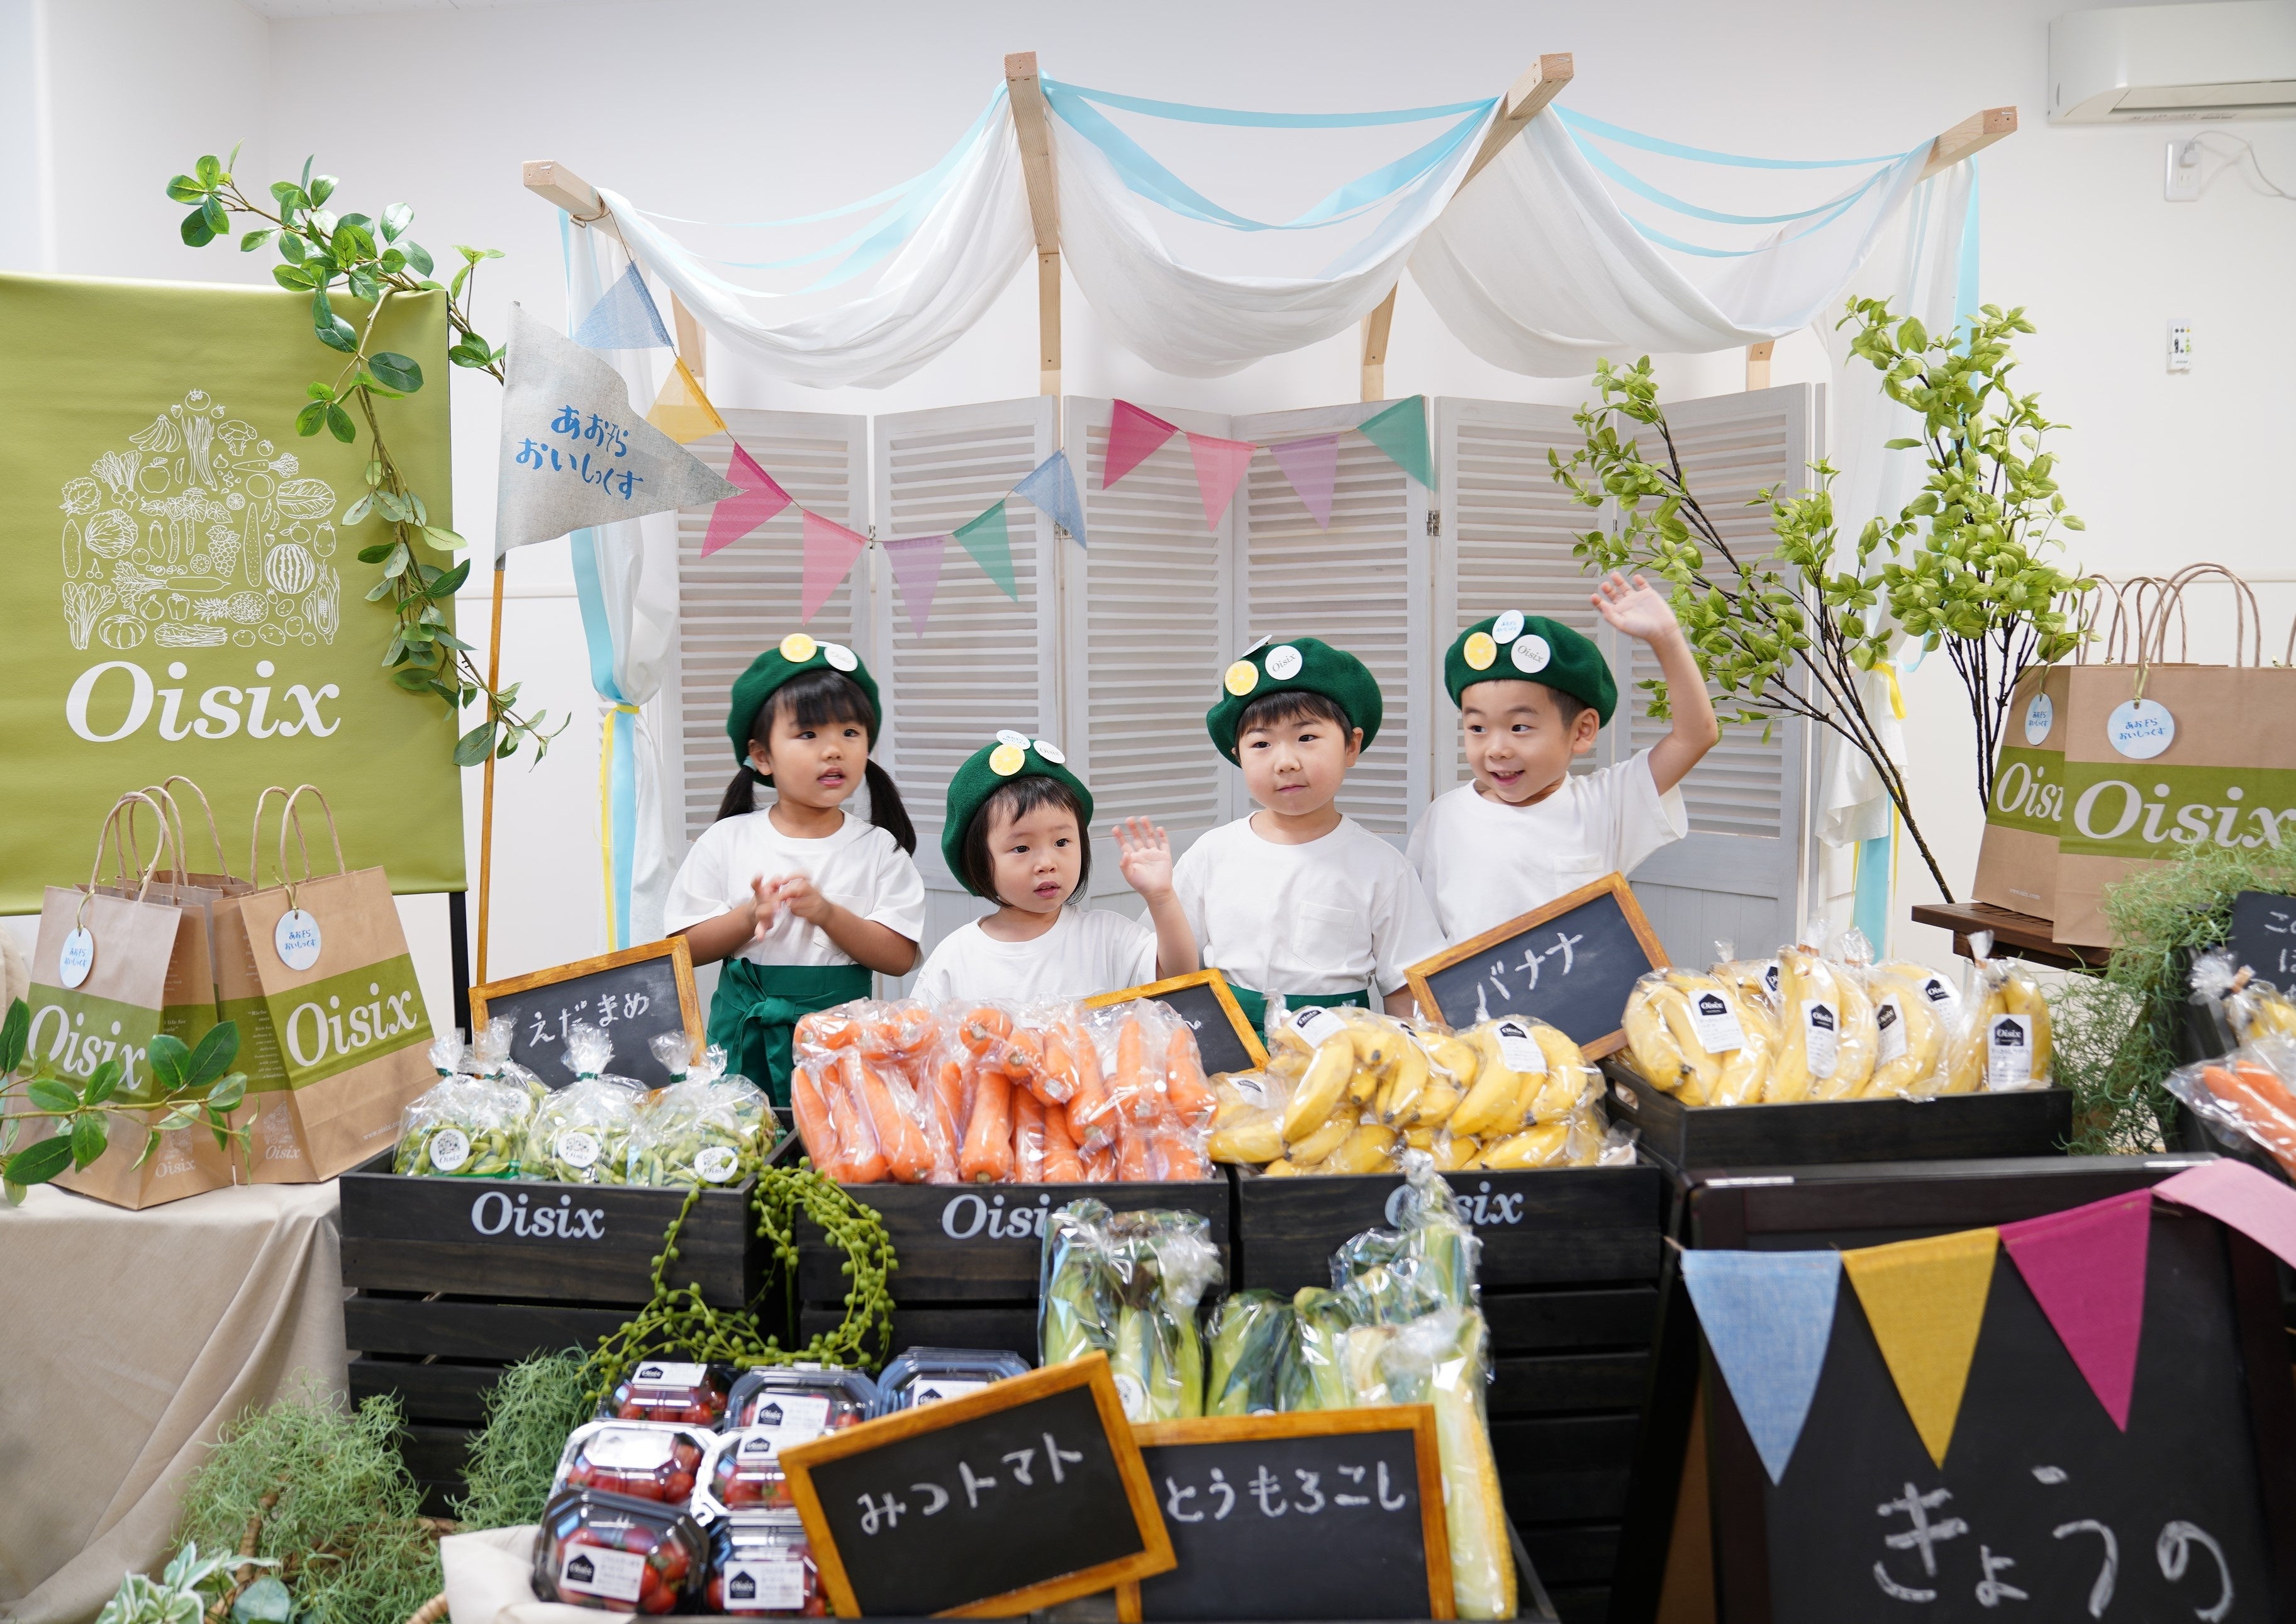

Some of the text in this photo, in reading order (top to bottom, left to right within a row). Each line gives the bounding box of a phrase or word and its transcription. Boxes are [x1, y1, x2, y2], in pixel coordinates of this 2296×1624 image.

[515, 437, 644, 500] おいしっくす
[1272, 654, 1296, 672] Oisix
[1518, 646, 1544, 663] Oisix
[65, 659, 341, 743] Oisix
[2119, 727, 2166, 741] おいしっくす
[2074, 780, 2296, 851] Oisix
[284, 939, 316, 951] おいしっくす
[1476, 932, 1585, 1008] バナナ
[287, 983, 417, 1067] Oisix
[528, 992, 650, 1048] えだまめ
[1701, 1002, 1724, 1010] Oisix
[28, 1005, 146, 1090] Oisix
[1997, 1029, 2022, 1039] Oisix
[155, 1158, 196, 1178] Oisix
[265, 1145, 301, 1160] Oisix
[472, 1191, 605, 1240] Oisix
[942, 1193, 1067, 1240] Oisi
[1385, 1181, 1524, 1228] Osix
[857, 1432, 1084, 1535] みつトマト
[1166, 1460, 1407, 1522] とうもろこし
[1873, 1465, 2234, 1623] きょうの
